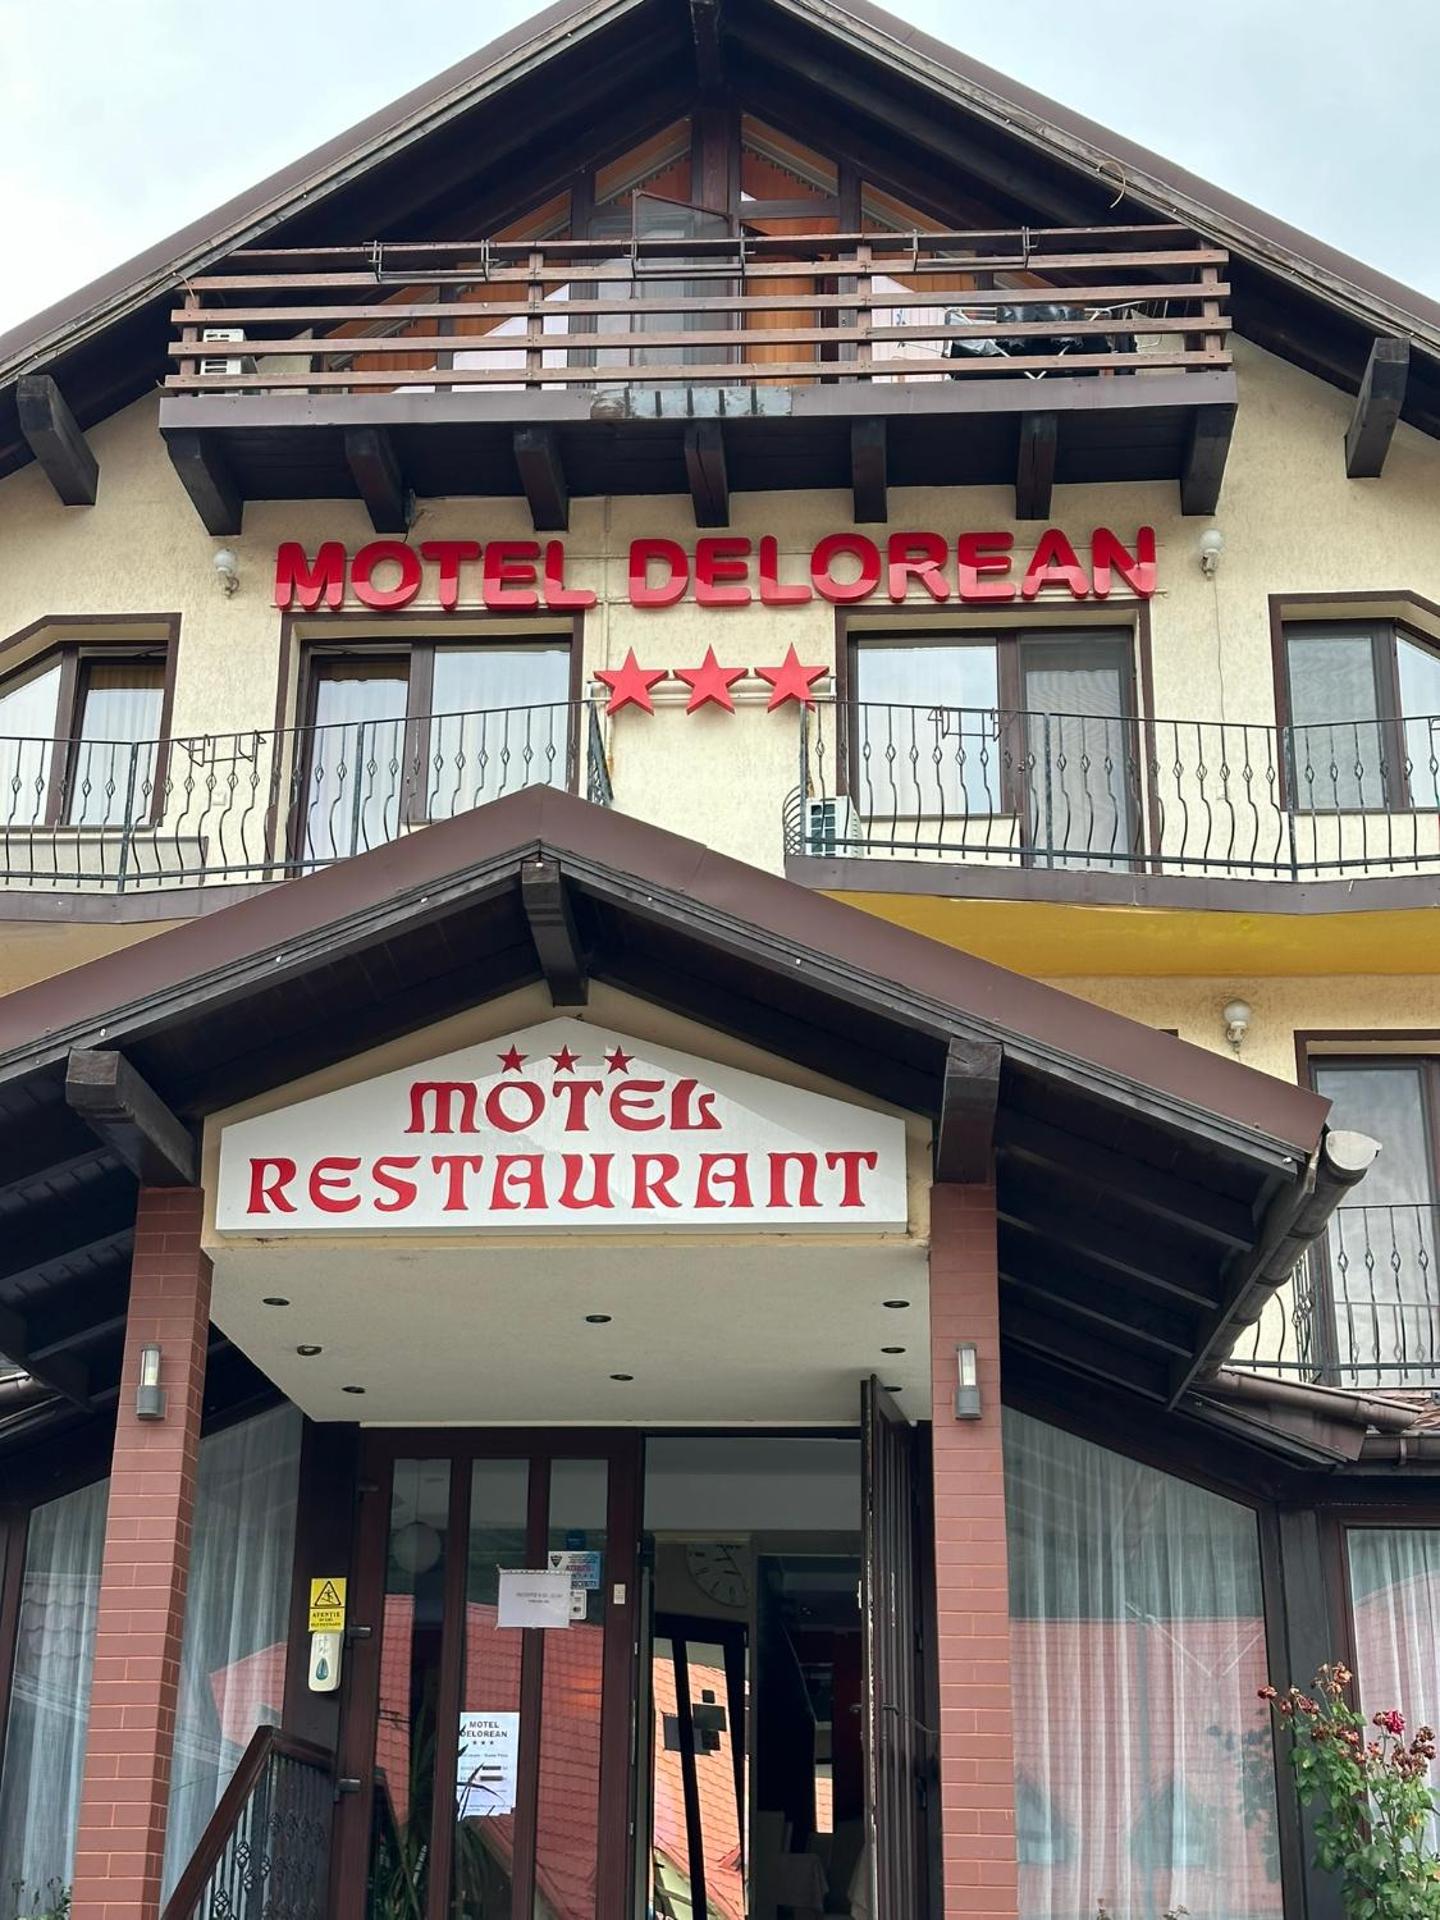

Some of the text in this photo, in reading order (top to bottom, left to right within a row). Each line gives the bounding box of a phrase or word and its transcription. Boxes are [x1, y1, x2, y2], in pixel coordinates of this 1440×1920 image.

[275, 527, 1157, 610] MOTEL DELOREAN
[404, 1080, 722, 1133] MOTEL
[246, 1151, 878, 1214] RESTAURANT
[469, 1721, 500, 1729] MOTEL
